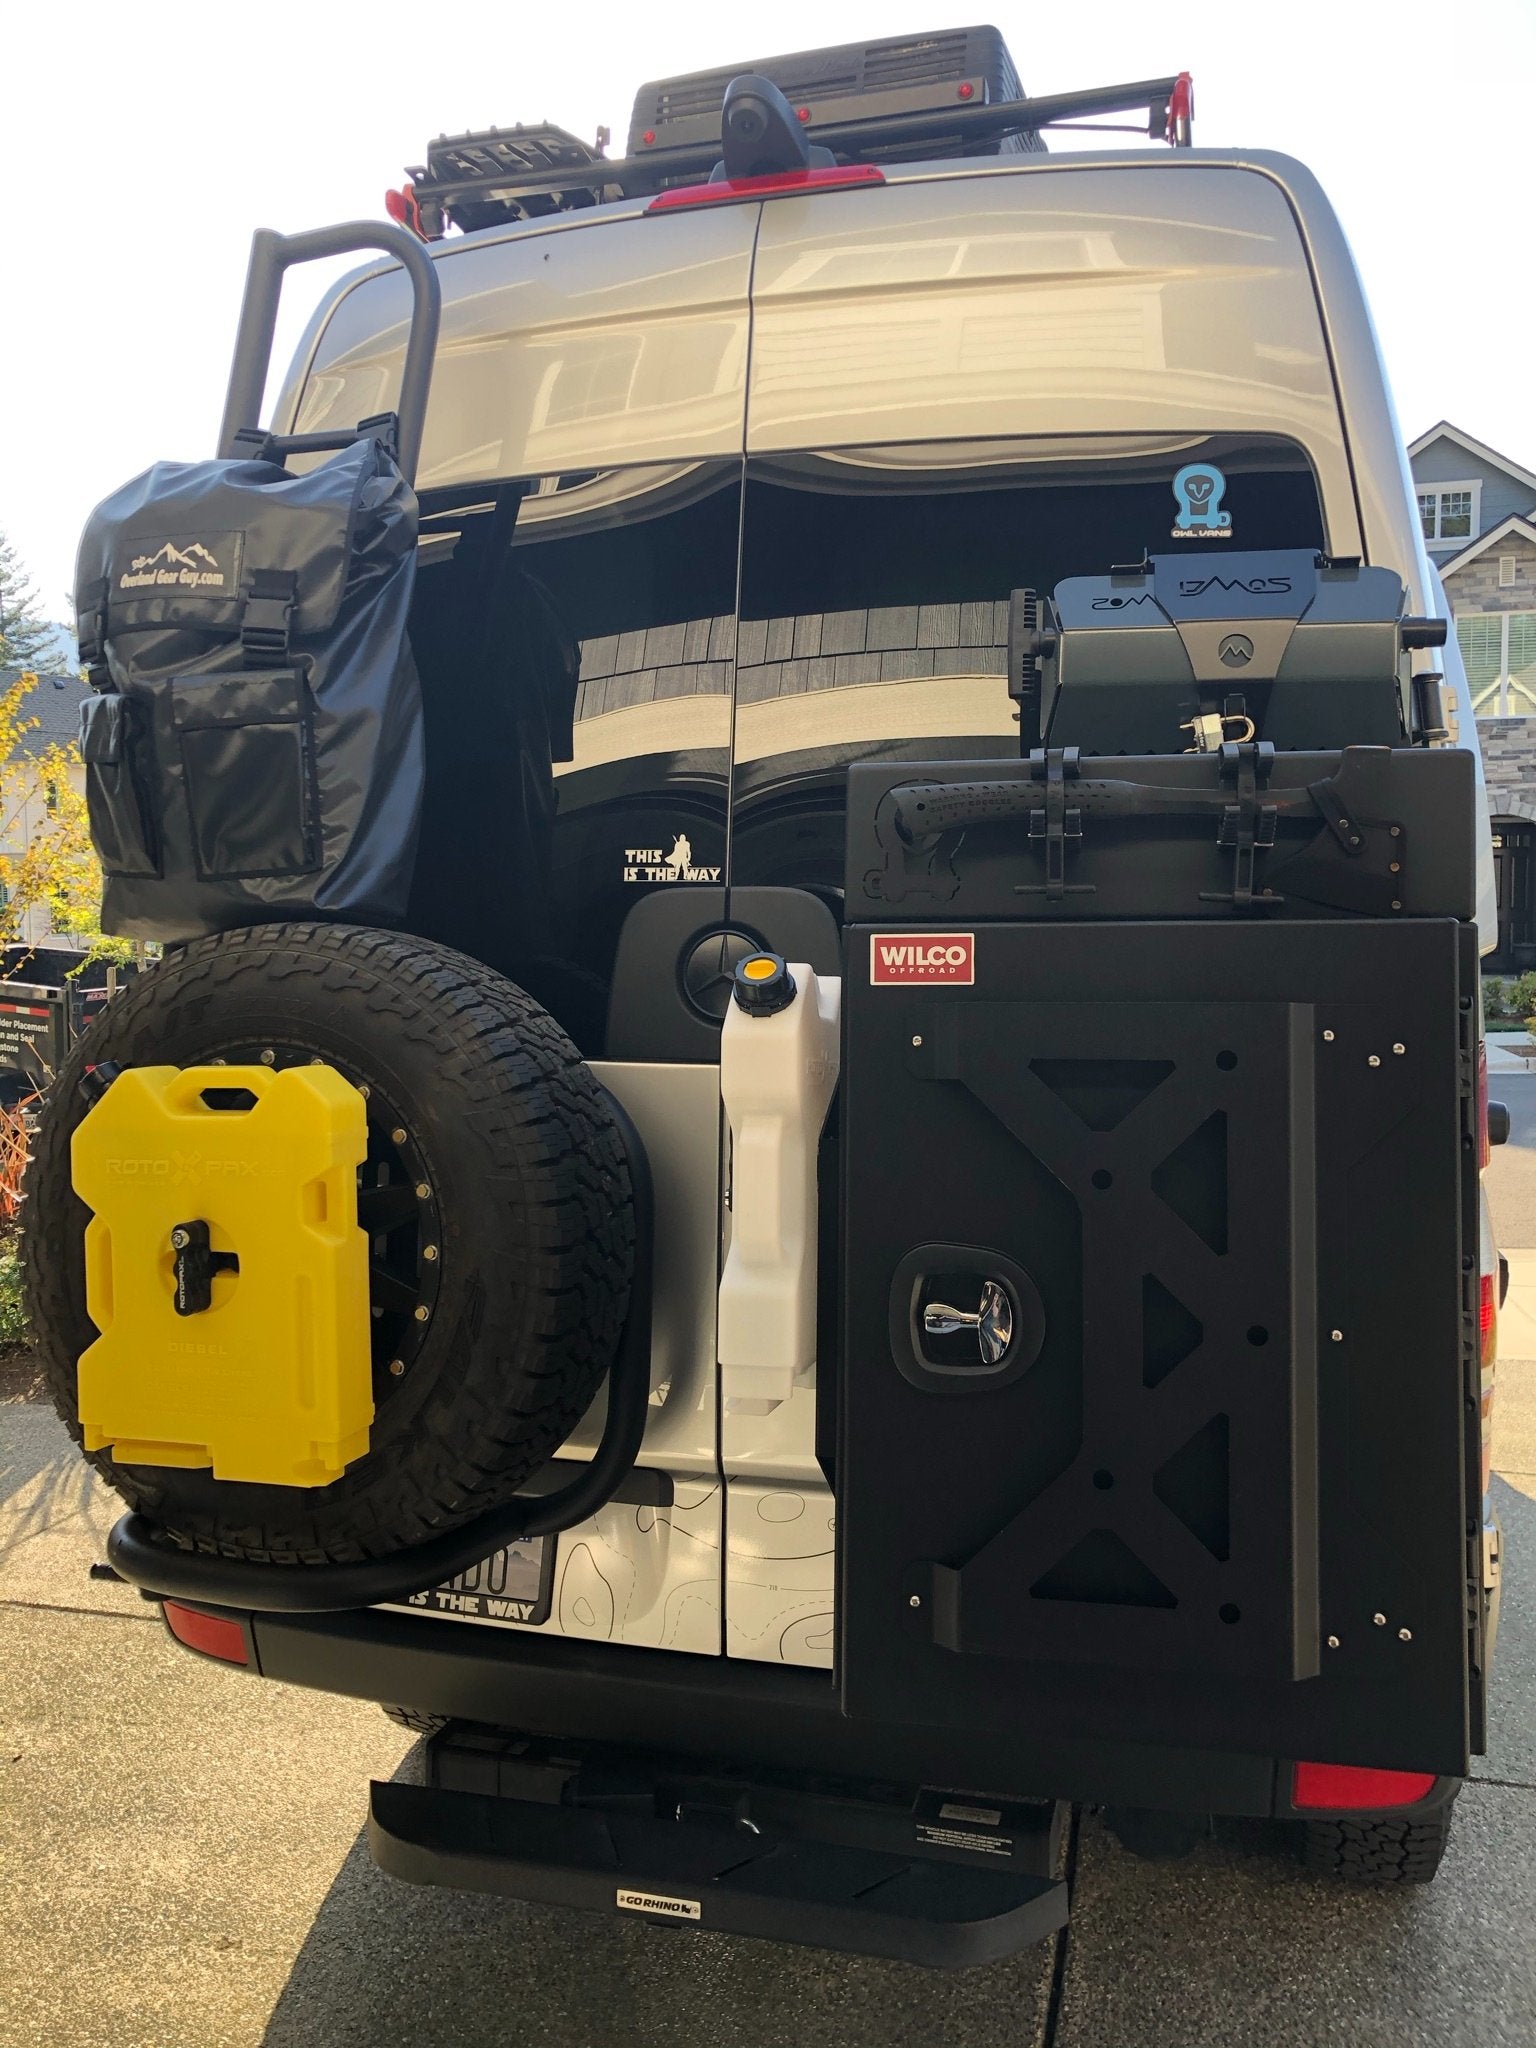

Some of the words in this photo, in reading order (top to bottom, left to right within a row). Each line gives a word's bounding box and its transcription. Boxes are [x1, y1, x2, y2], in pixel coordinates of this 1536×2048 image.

[120, 569, 157, 588] Overland
[157, 568, 178, 585] Gear
[179, 567, 224, 588] Guy.com
[625, 849, 663, 863] THIS
[624, 867, 638, 881] IS
[645, 867, 677, 881] THE
[687, 867, 720, 881] WAY
[880, 945, 967, 966] WILCO
[13, 1020, 48, 1032] Placement
[6, 1032, 18, 1040] and
[20, 1033, 34, 1043] Seal
[408, 1590, 429, 1606] IS
[436, 1592, 480, 1614] THE
[487, 1599, 535, 1620] WAY
